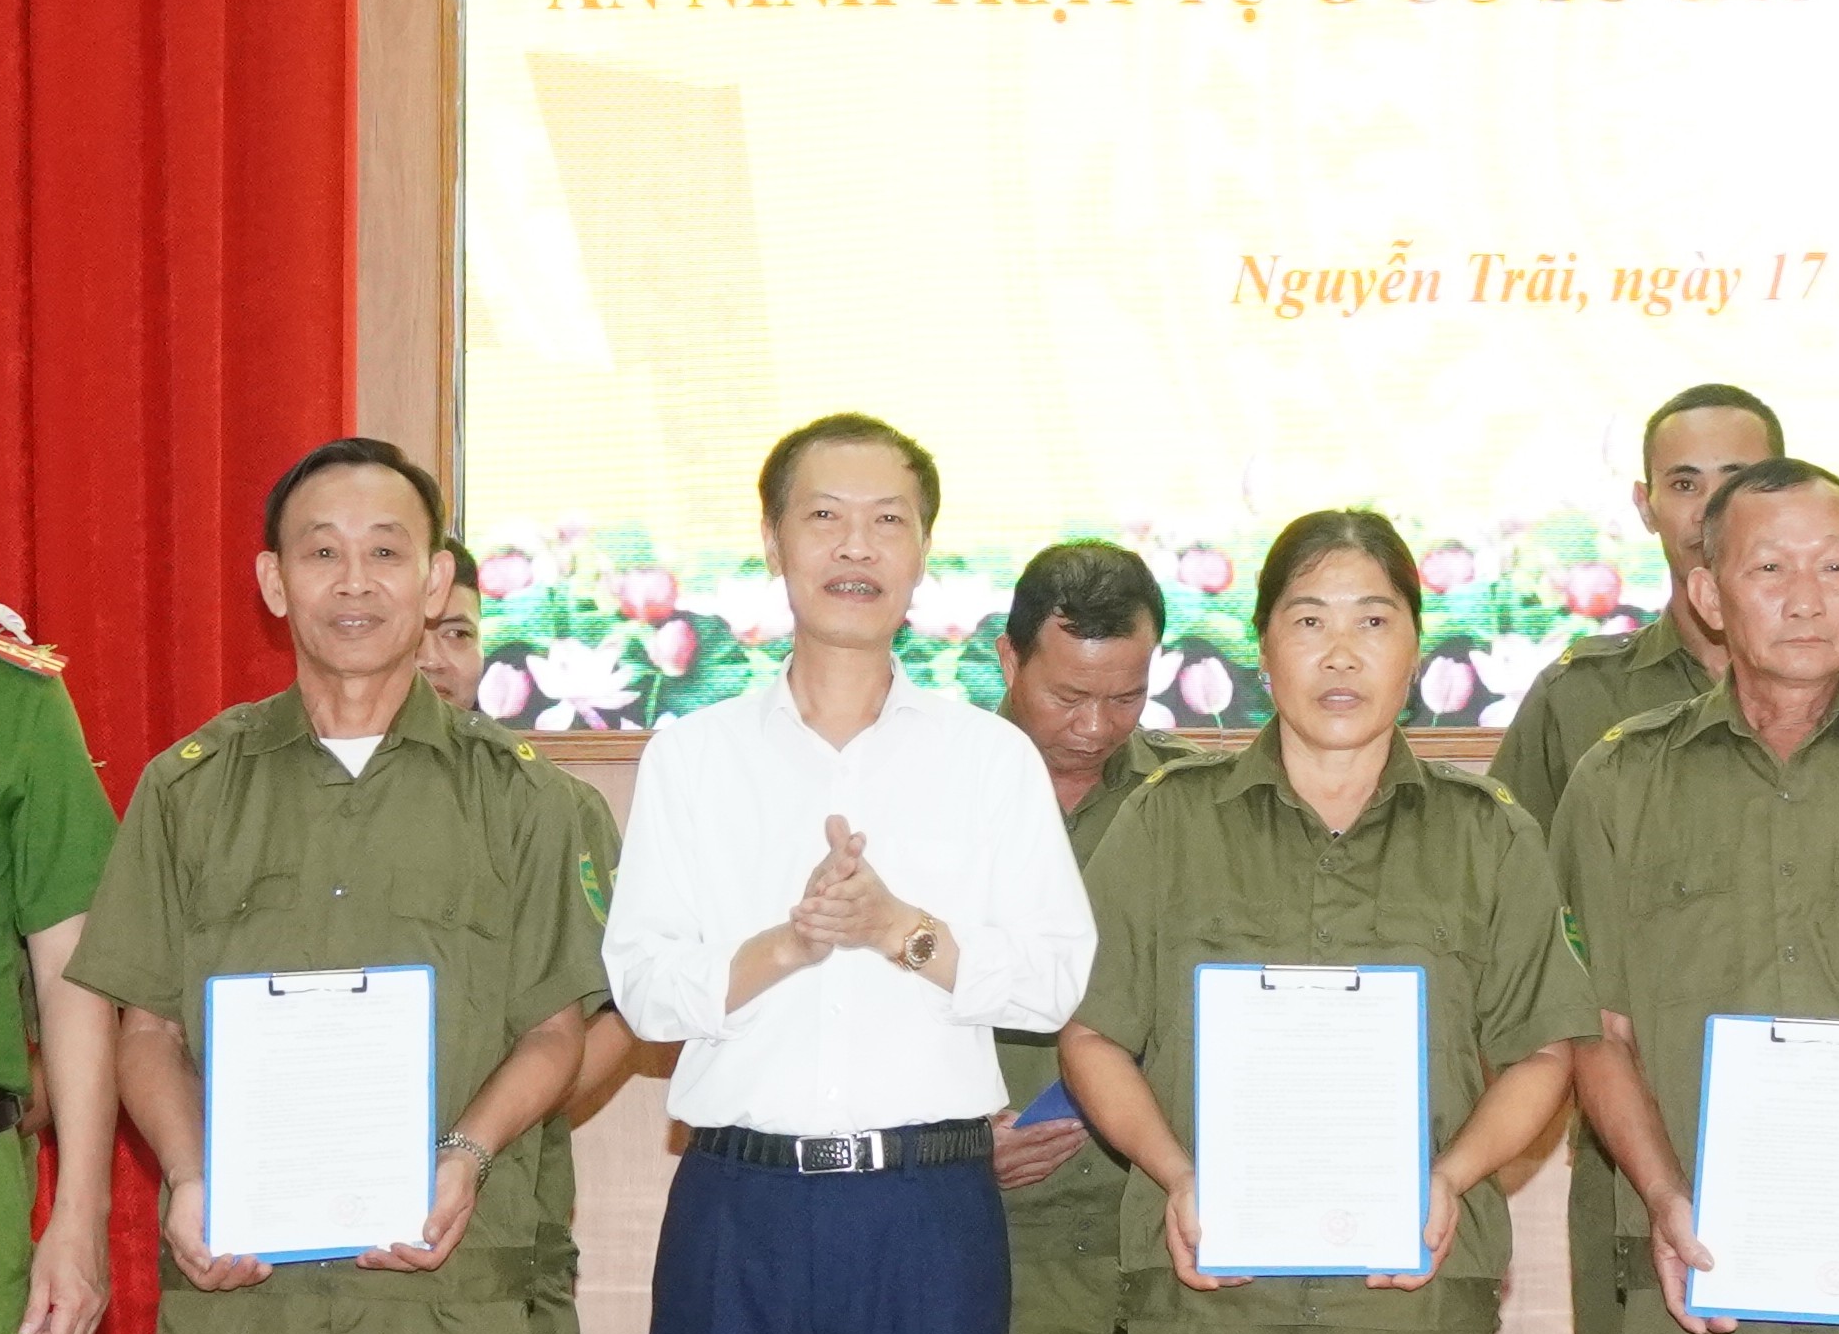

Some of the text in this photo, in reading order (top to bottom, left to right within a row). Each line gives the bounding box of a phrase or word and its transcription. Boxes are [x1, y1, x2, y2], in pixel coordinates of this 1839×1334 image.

[1231, 238, 1443, 320] Nguyễn
[1469, 251, 1590, 313] Trãi,
[1609, 250, 1743, 318] ngày
[1765, 250, 1829, 303] 17
